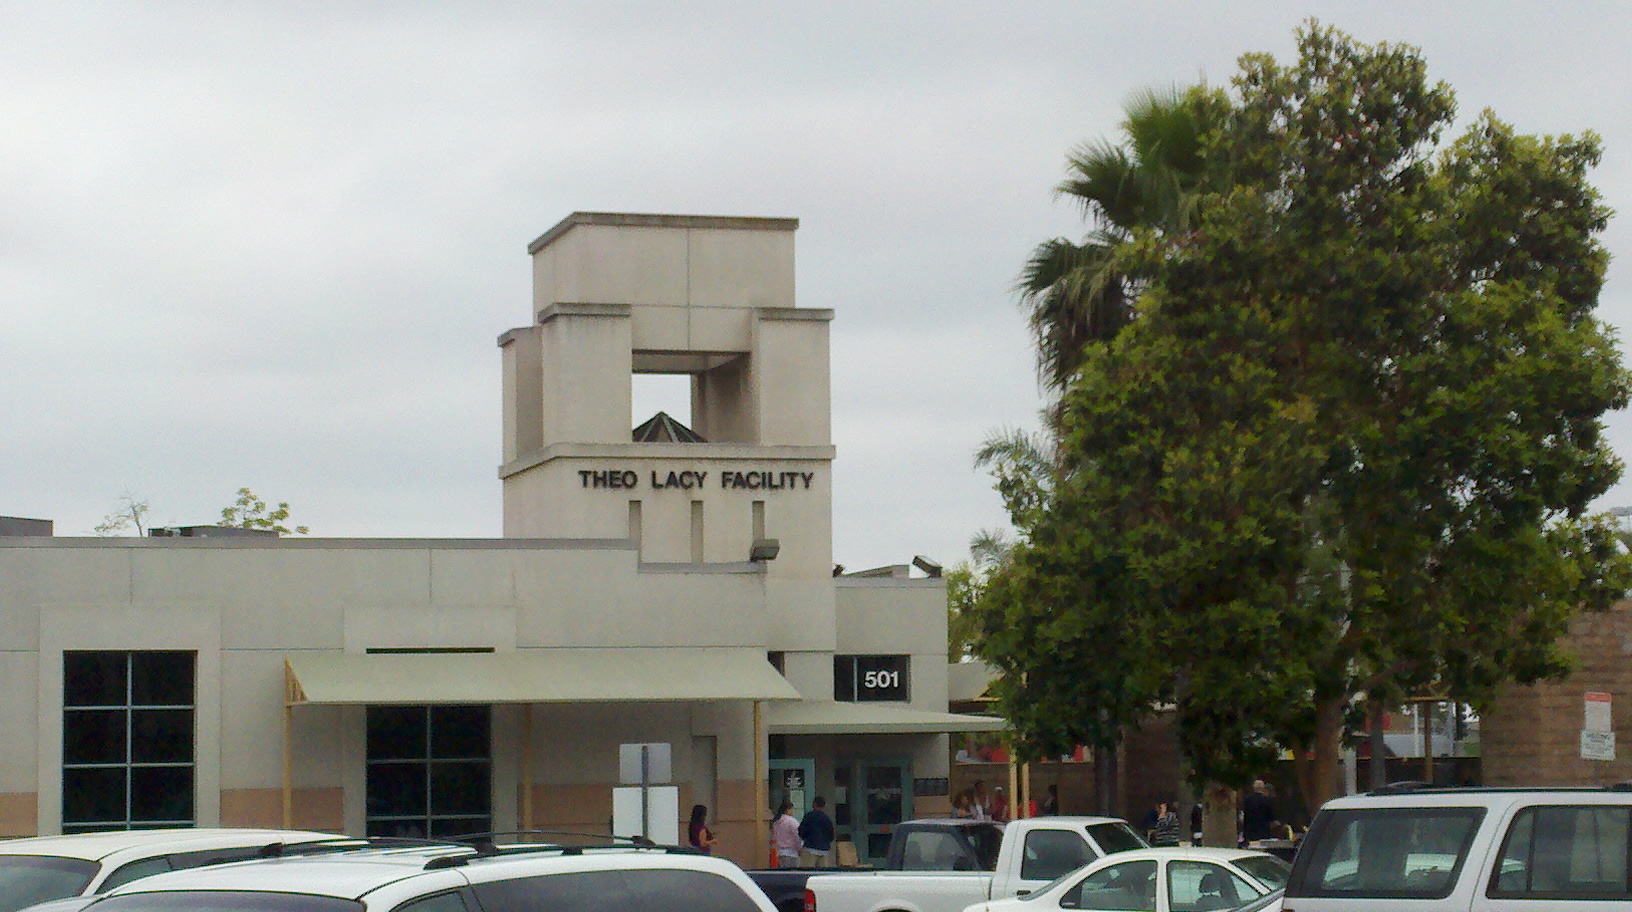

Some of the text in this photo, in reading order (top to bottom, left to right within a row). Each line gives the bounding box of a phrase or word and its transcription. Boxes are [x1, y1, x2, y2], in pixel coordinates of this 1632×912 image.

[578, 470, 814, 490] THEO LACY FACILITY
[864, 670, 899, 688] 501
